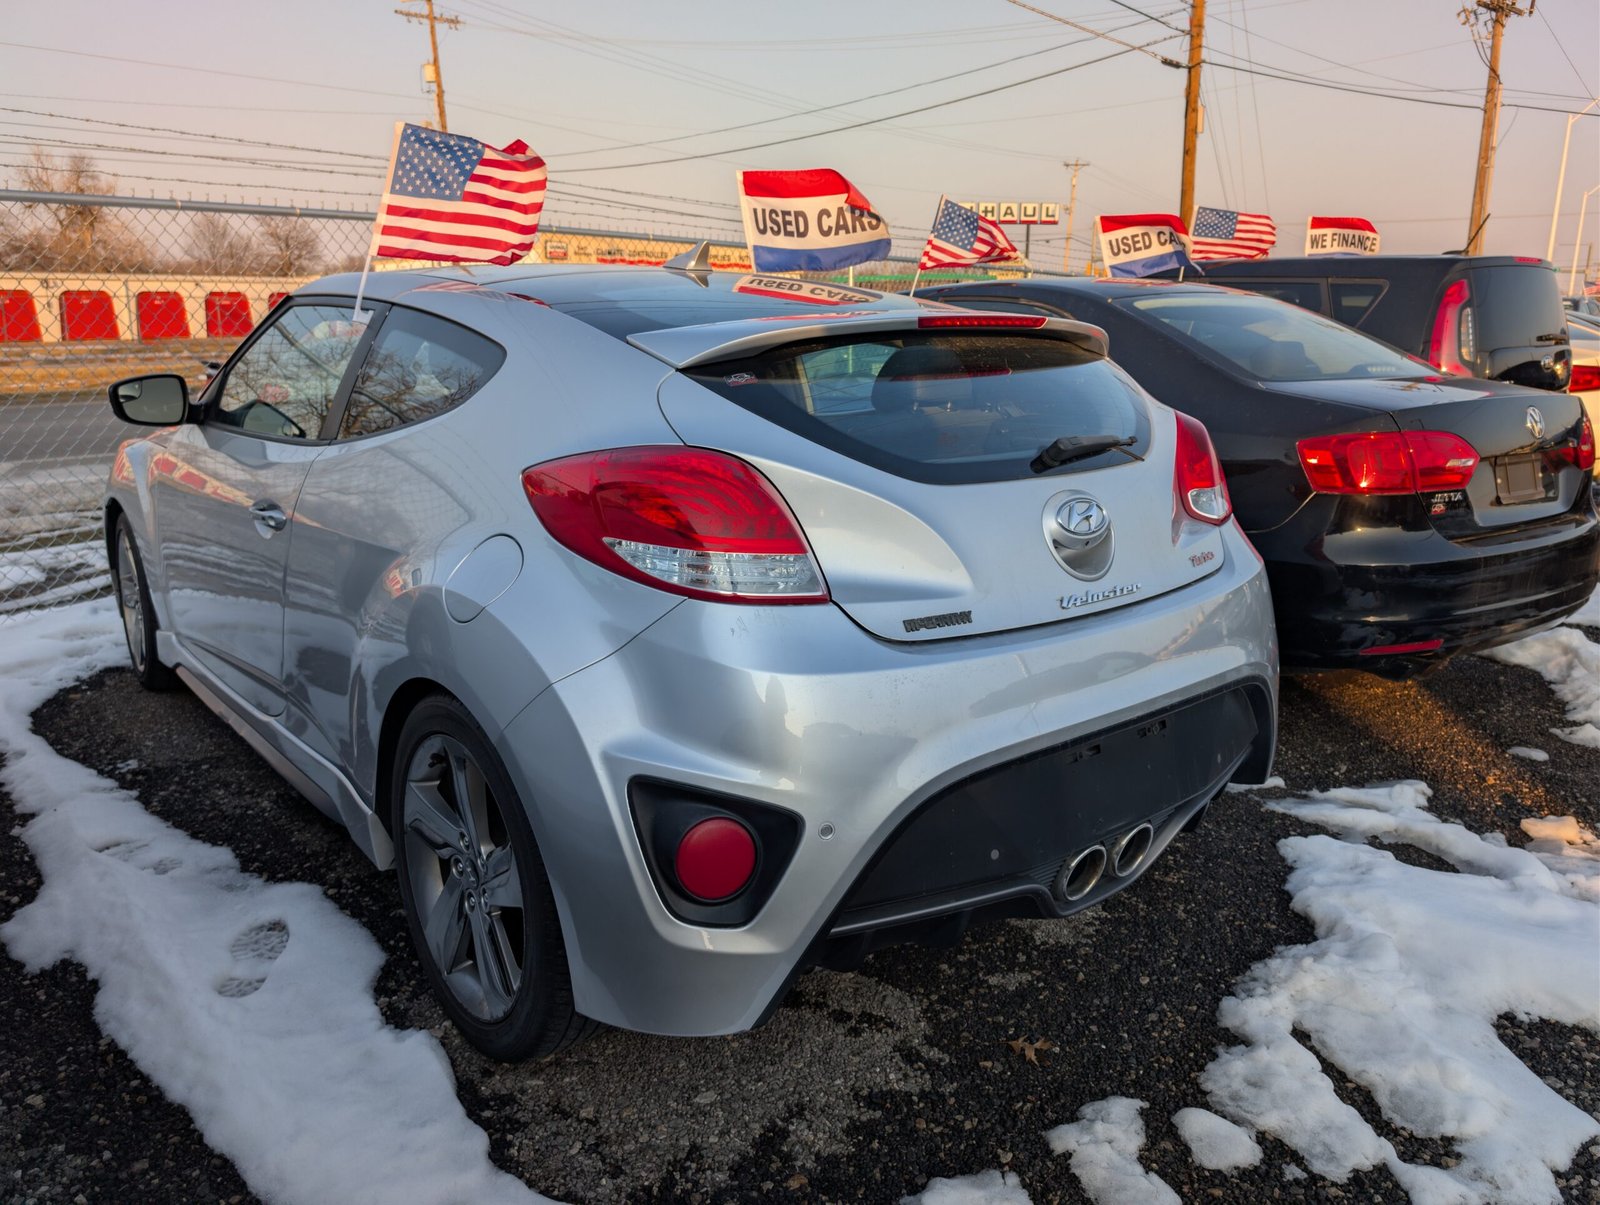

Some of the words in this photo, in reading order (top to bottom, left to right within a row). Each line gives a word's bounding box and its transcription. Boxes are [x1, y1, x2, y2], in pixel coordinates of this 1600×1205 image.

[753, 207, 810, 238] USED
[1109, 231, 1152, 257] USED
[1310, 233, 1328, 249] WE
[1330, 232, 1377, 253] FINANCE
[1431, 491, 1463, 503] JETTA
[1057, 582, 1142, 610] Veloster
